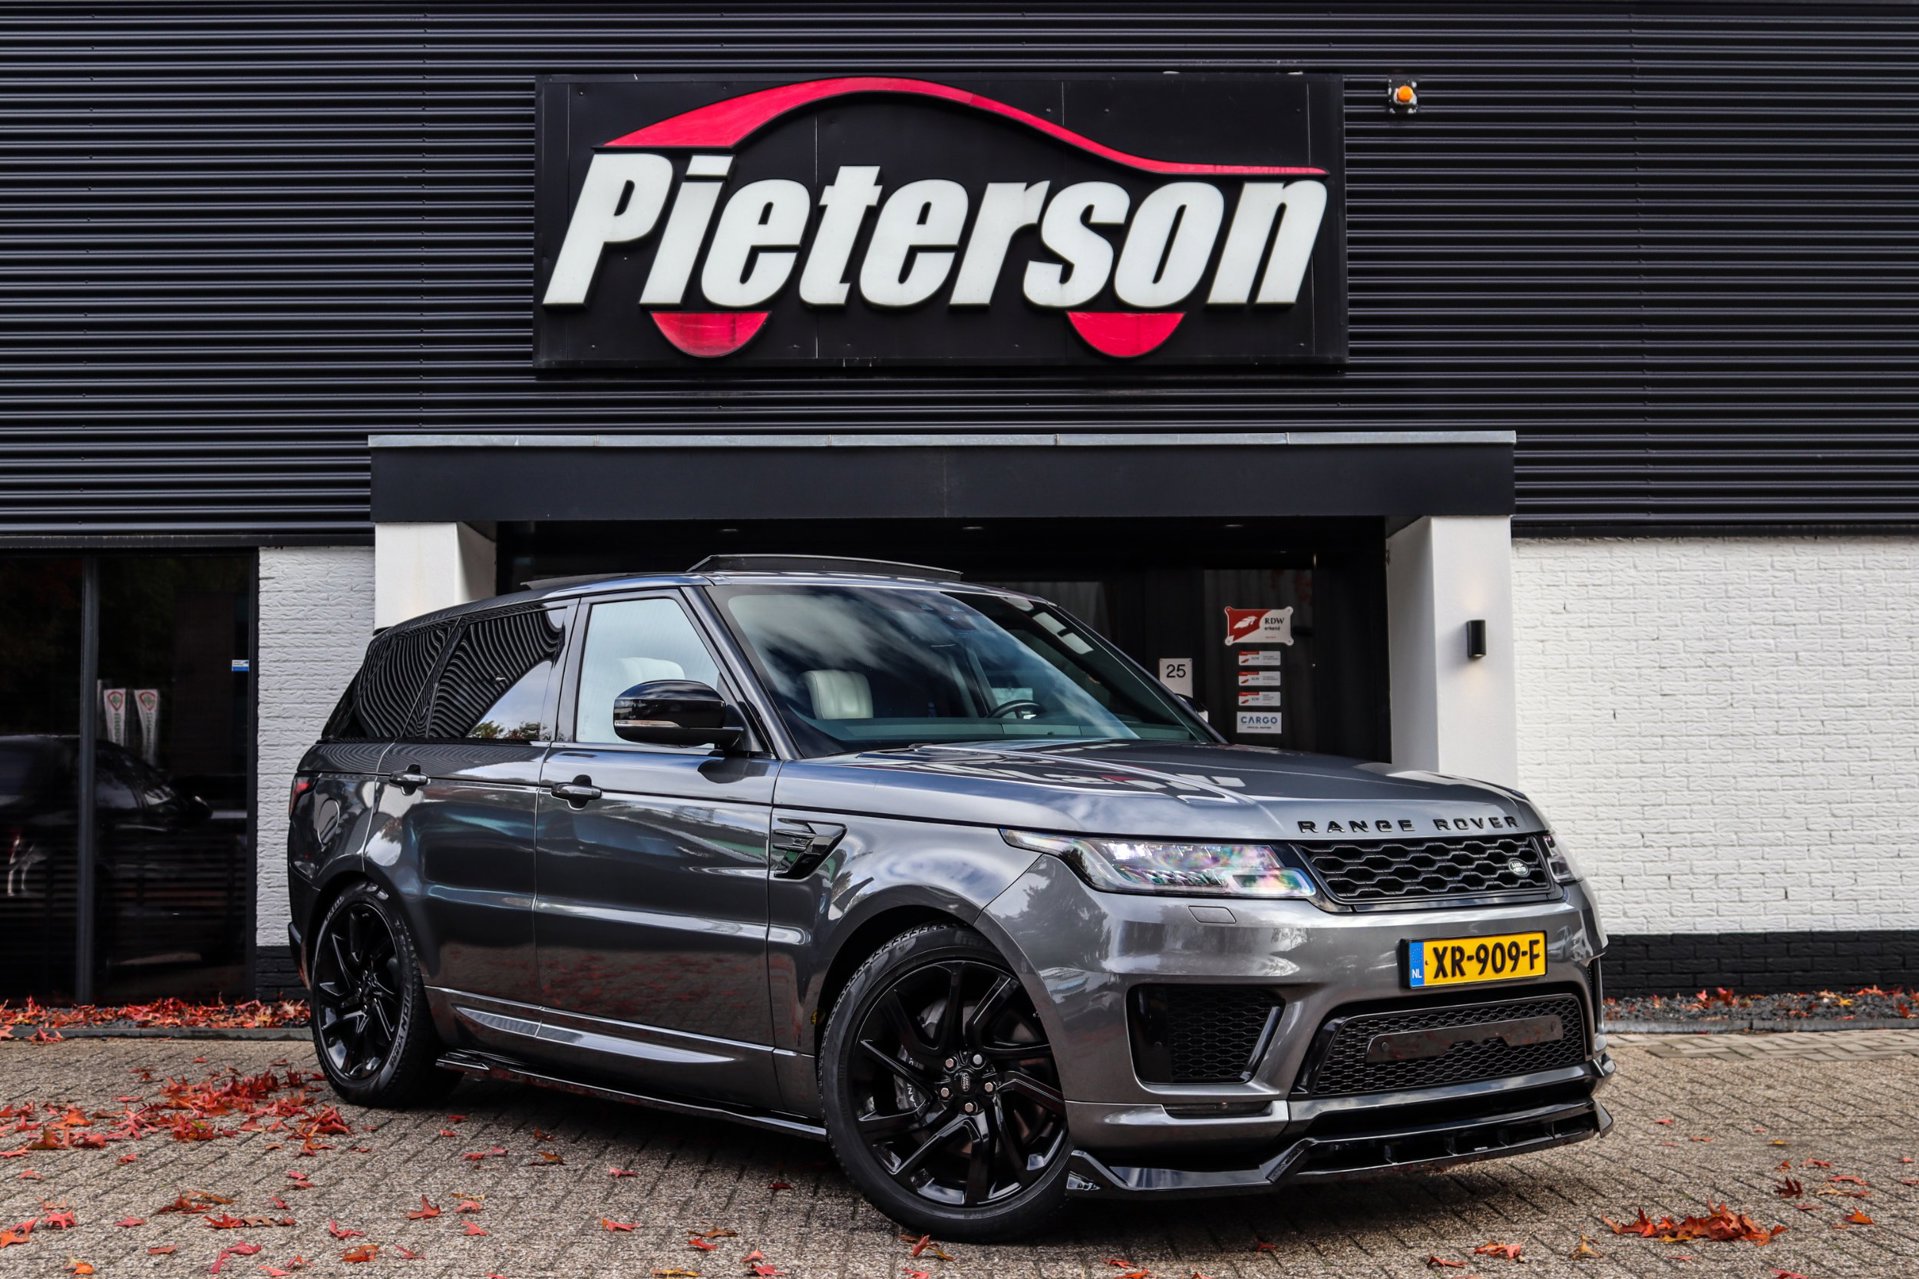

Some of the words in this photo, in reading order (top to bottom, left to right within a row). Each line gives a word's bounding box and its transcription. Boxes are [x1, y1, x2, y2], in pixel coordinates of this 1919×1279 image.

[543, 152, 1328, 308] Pieterson
[1264, 617, 1285, 625] RDW
[1166, 663, 1187, 679] 25
[1240, 715, 1279, 725] CARGO
[1297, 819, 1416, 834] RANGE
[1432, 815, 1520, 831] ROVER
[1432, 938, 1541, 980] XR-909-F
[1411, 968, 1423, 979] NL
